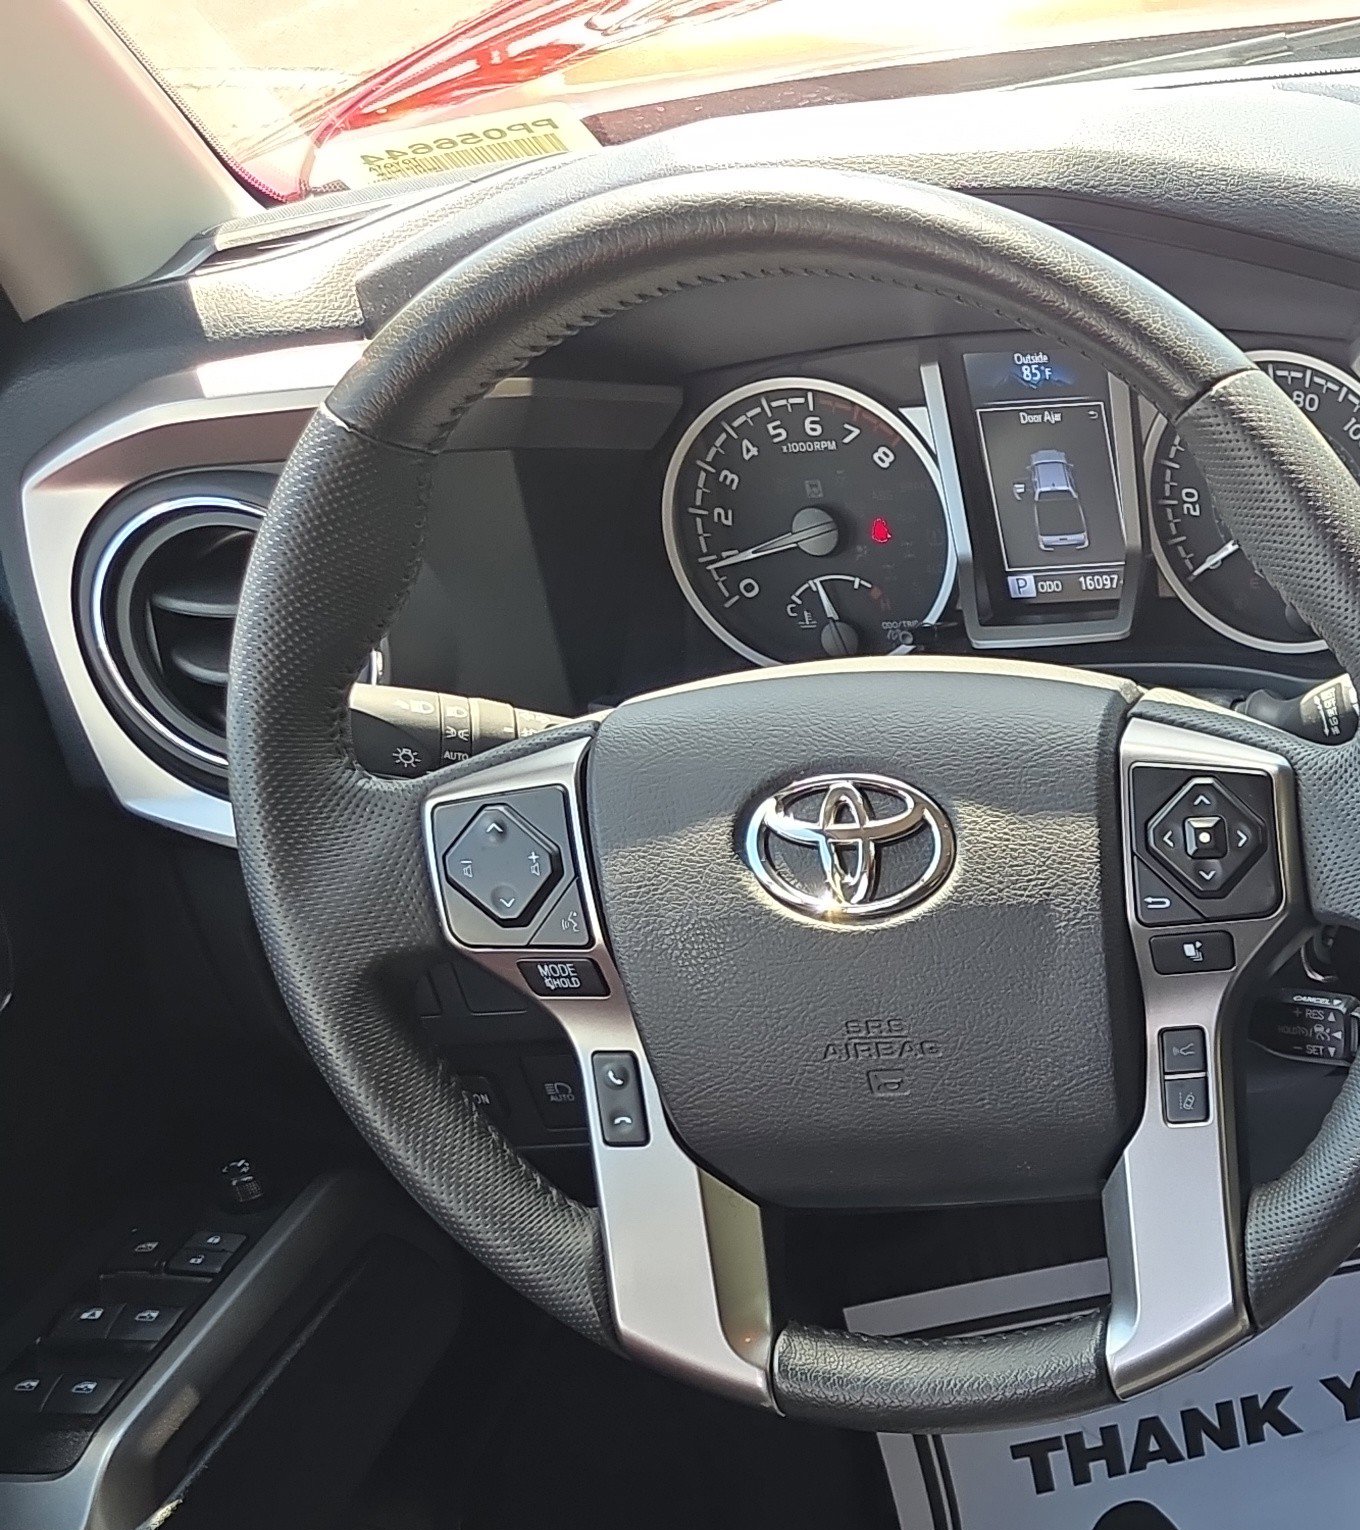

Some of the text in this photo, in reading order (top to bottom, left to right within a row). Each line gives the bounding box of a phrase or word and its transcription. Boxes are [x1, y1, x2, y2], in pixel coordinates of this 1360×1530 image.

[1013, 352, 1048, 366] Outside
[1291, 390, 1320, 413] 80
[1020, 410, 1061, 424] Door Ajar
[767, 420, 787, 442] 5
[804, 417, 822, 436] 6
[842, 424, 860, 443] 7
[741, 440, 758, 460] 4
[872, 446, 895, 468] 8
[719, 469, 739, 490] 3
[1181, 487, 1200, 517] 20
[713, 507, 733, 526] 2
[739, 578, 760, 598] 0
[1017, 577, 1028, 594] P
[1037, 579, 1061, 593] ODO
[786, 603, 798, 617] C
[444, 751, 469, 761] AUTO
[537, 963, 577, 977] MODE
[553, 976, 580, 988] HOLD
[1305, 1009, 1324, 1020] RES
[845, 1018, 908, 1036] SRS
[823, 1040, 942, 1061] AIRBAG
[1306, 1045, 1324, 1056] SET
[550, 1094, 575, 1102] AUTO
[1010, 1385, 1304, 1497] THANK
